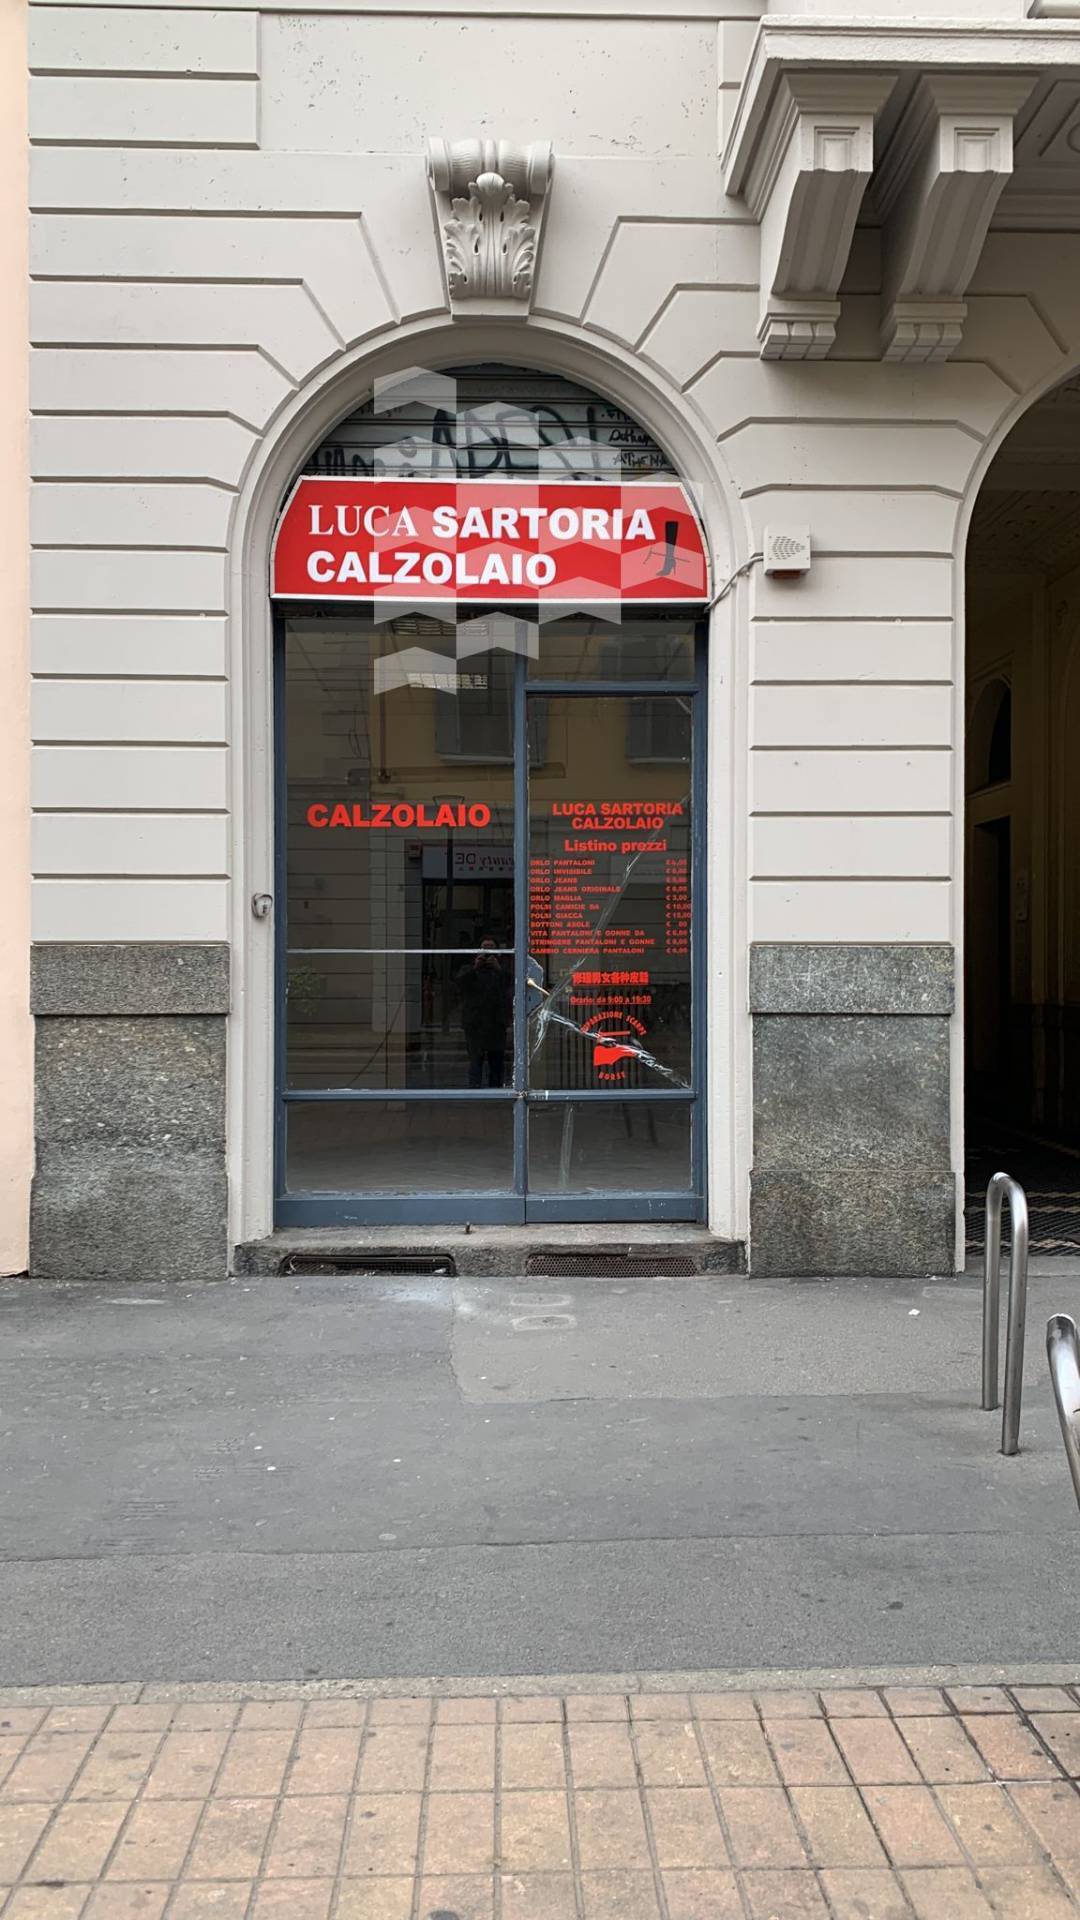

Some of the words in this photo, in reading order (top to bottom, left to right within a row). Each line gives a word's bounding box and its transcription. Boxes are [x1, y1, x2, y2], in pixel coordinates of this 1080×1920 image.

[308, 504, 419, 537] LUCA
[432, 505, 657, 541] SARTORIA
[307, 550, 557, 585] CALZOLAIO
[306, 803, 491, 828] CALZOLAIO
[552, 803, 597, 816] LUCA
[600, 803, 684, 816] SARTORIA
[571, 817, 665, 830] CALZOLAIO
[564, 840, 618, 852] Listino
[621, 840, 668, 854] prezzi
